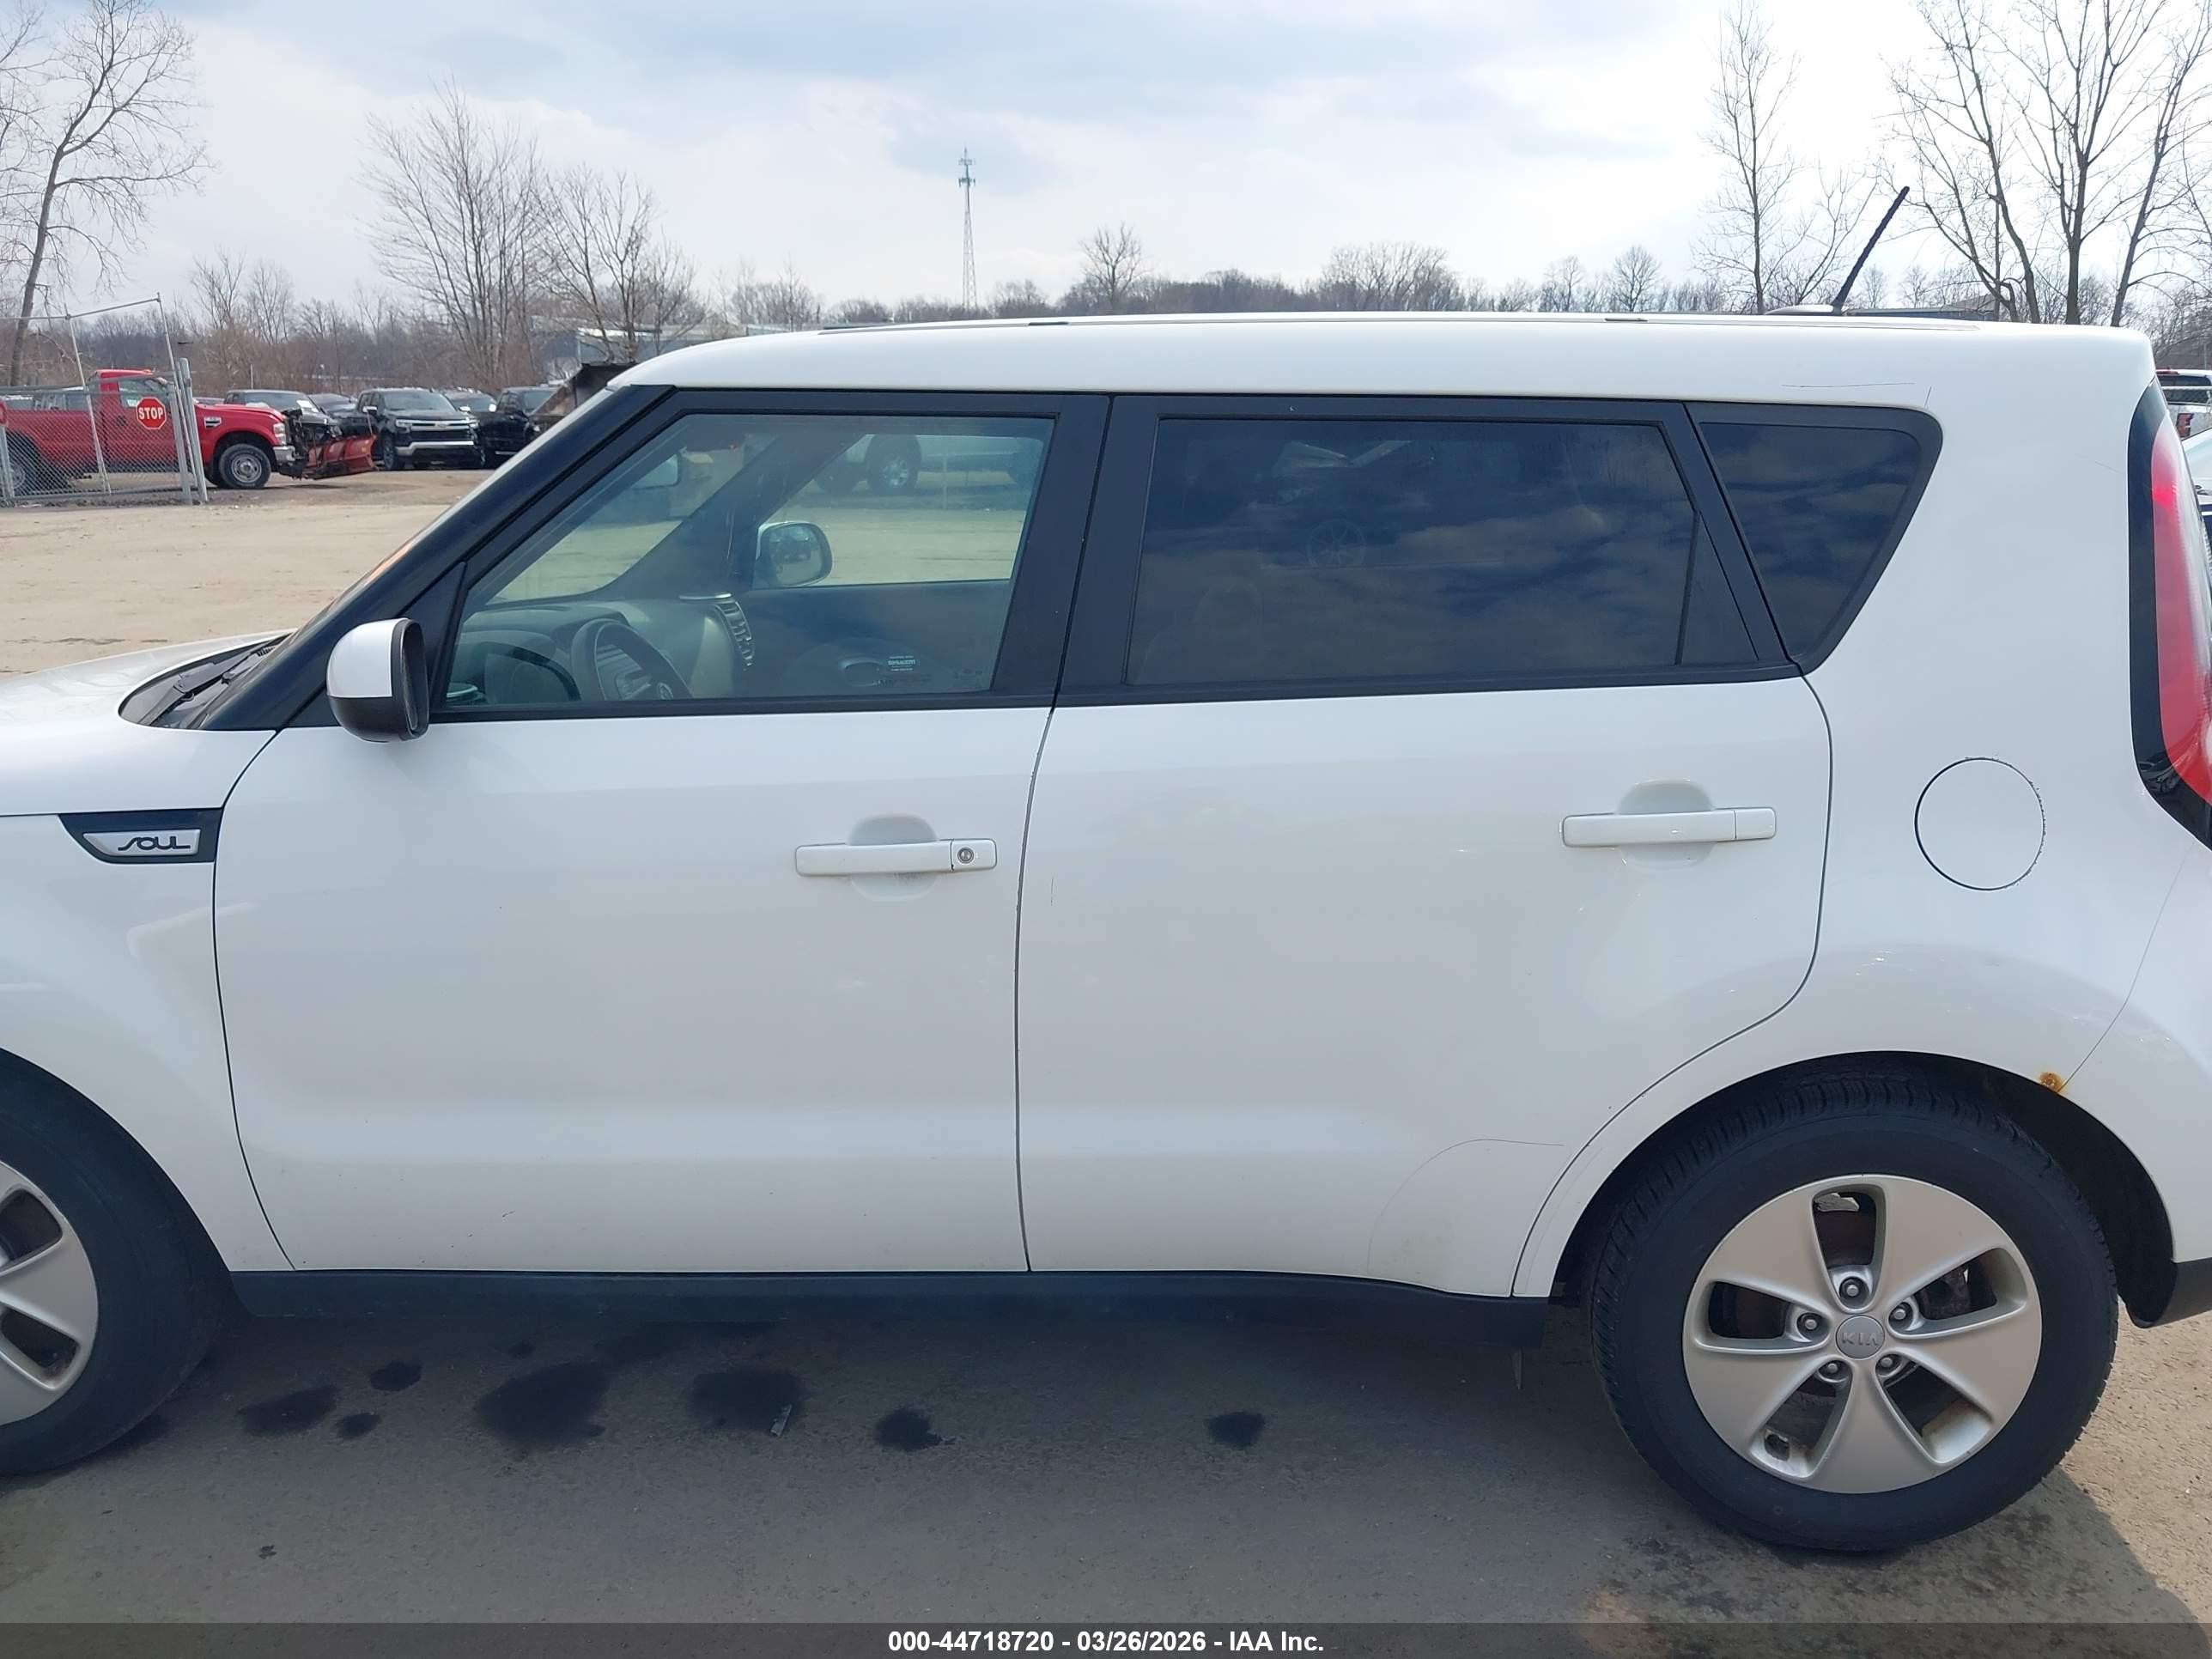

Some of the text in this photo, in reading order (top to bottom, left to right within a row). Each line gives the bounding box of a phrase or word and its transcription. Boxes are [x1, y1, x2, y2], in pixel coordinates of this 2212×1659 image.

[138, 407, 164, 420] STOP
[118, 836, 191, 851] SOUL
[1841, 1331, 1880, 1346] KIA
